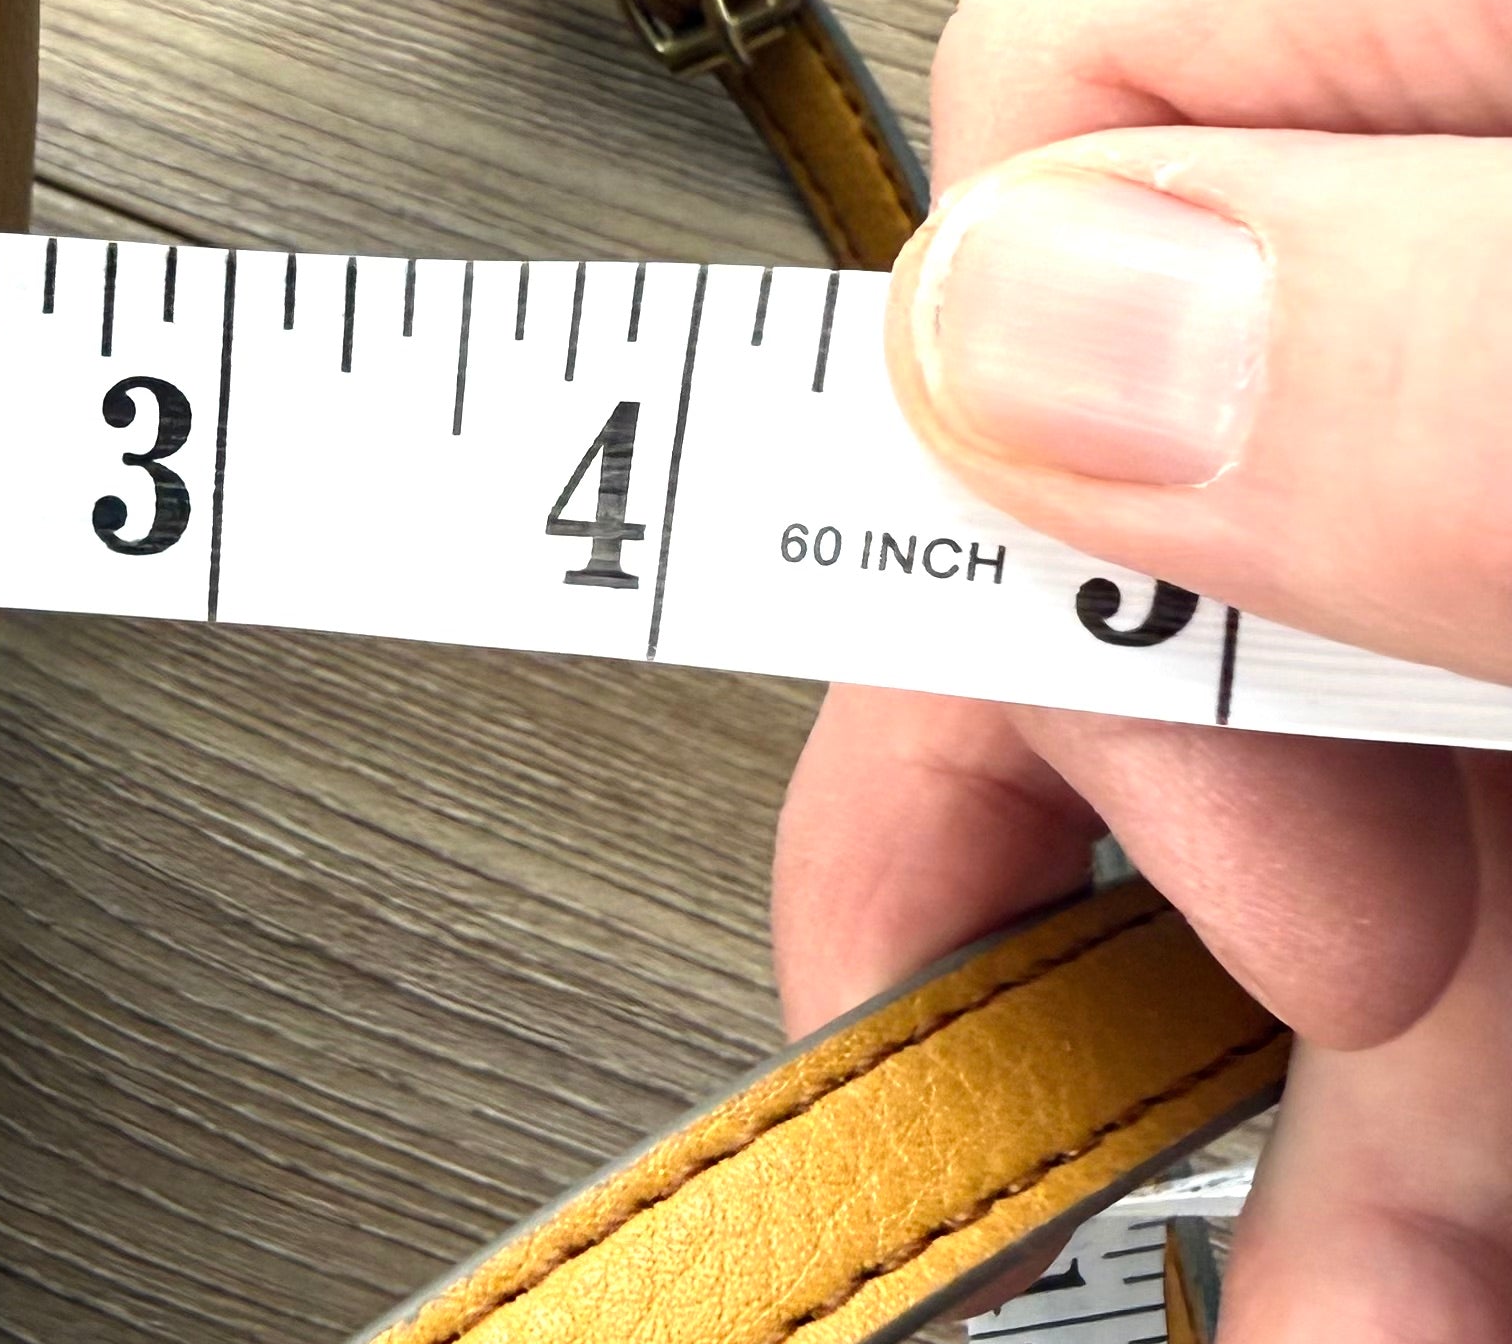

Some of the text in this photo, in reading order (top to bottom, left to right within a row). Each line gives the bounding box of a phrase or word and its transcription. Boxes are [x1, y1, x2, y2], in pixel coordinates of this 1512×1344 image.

[91, 375, 193, 556] 3
[545, 401, 646, 590] 4
[781, 522, 1006, 585] 60 INCH
